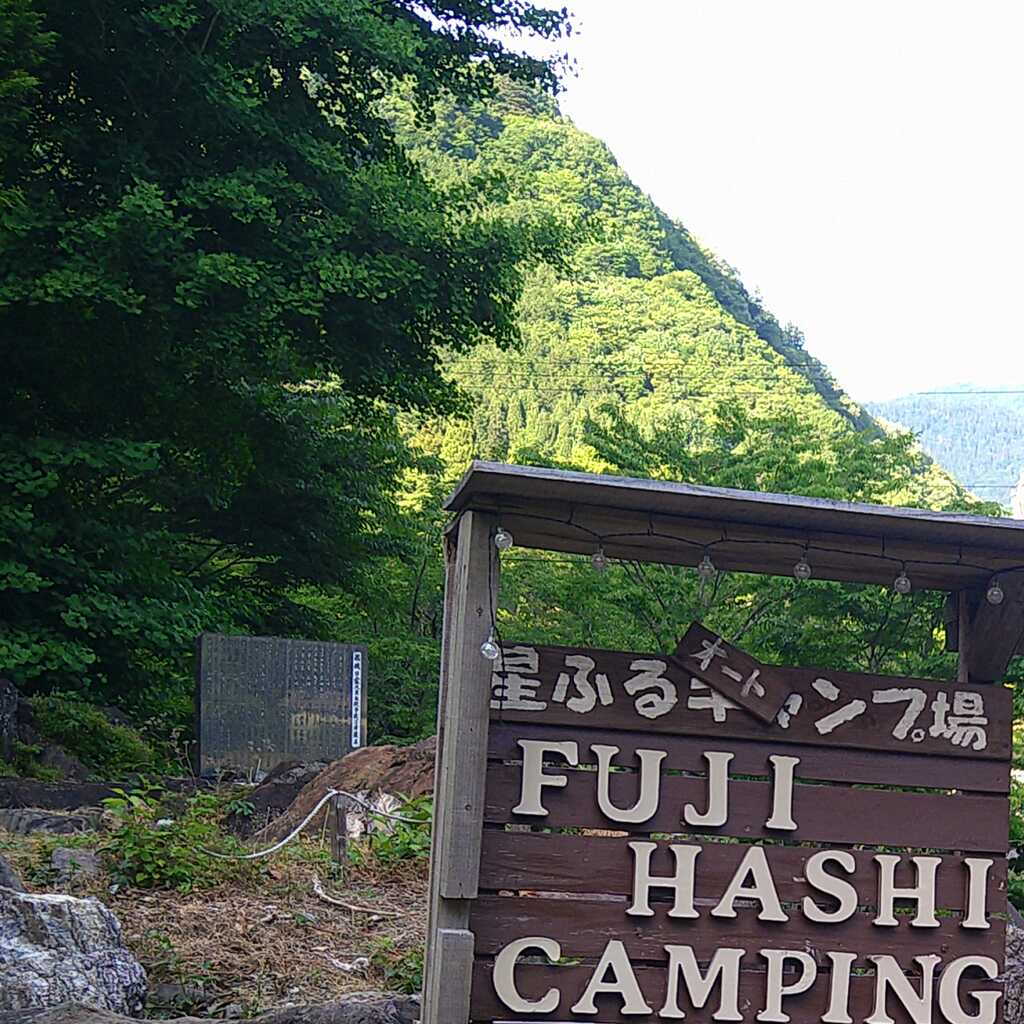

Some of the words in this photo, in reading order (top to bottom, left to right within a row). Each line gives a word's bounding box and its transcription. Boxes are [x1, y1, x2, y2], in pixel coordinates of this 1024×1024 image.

[689, 637, 766, 698] オート
[511, 739, 801, 831] FUJI
[626, 841, 994, 929] HASHI
